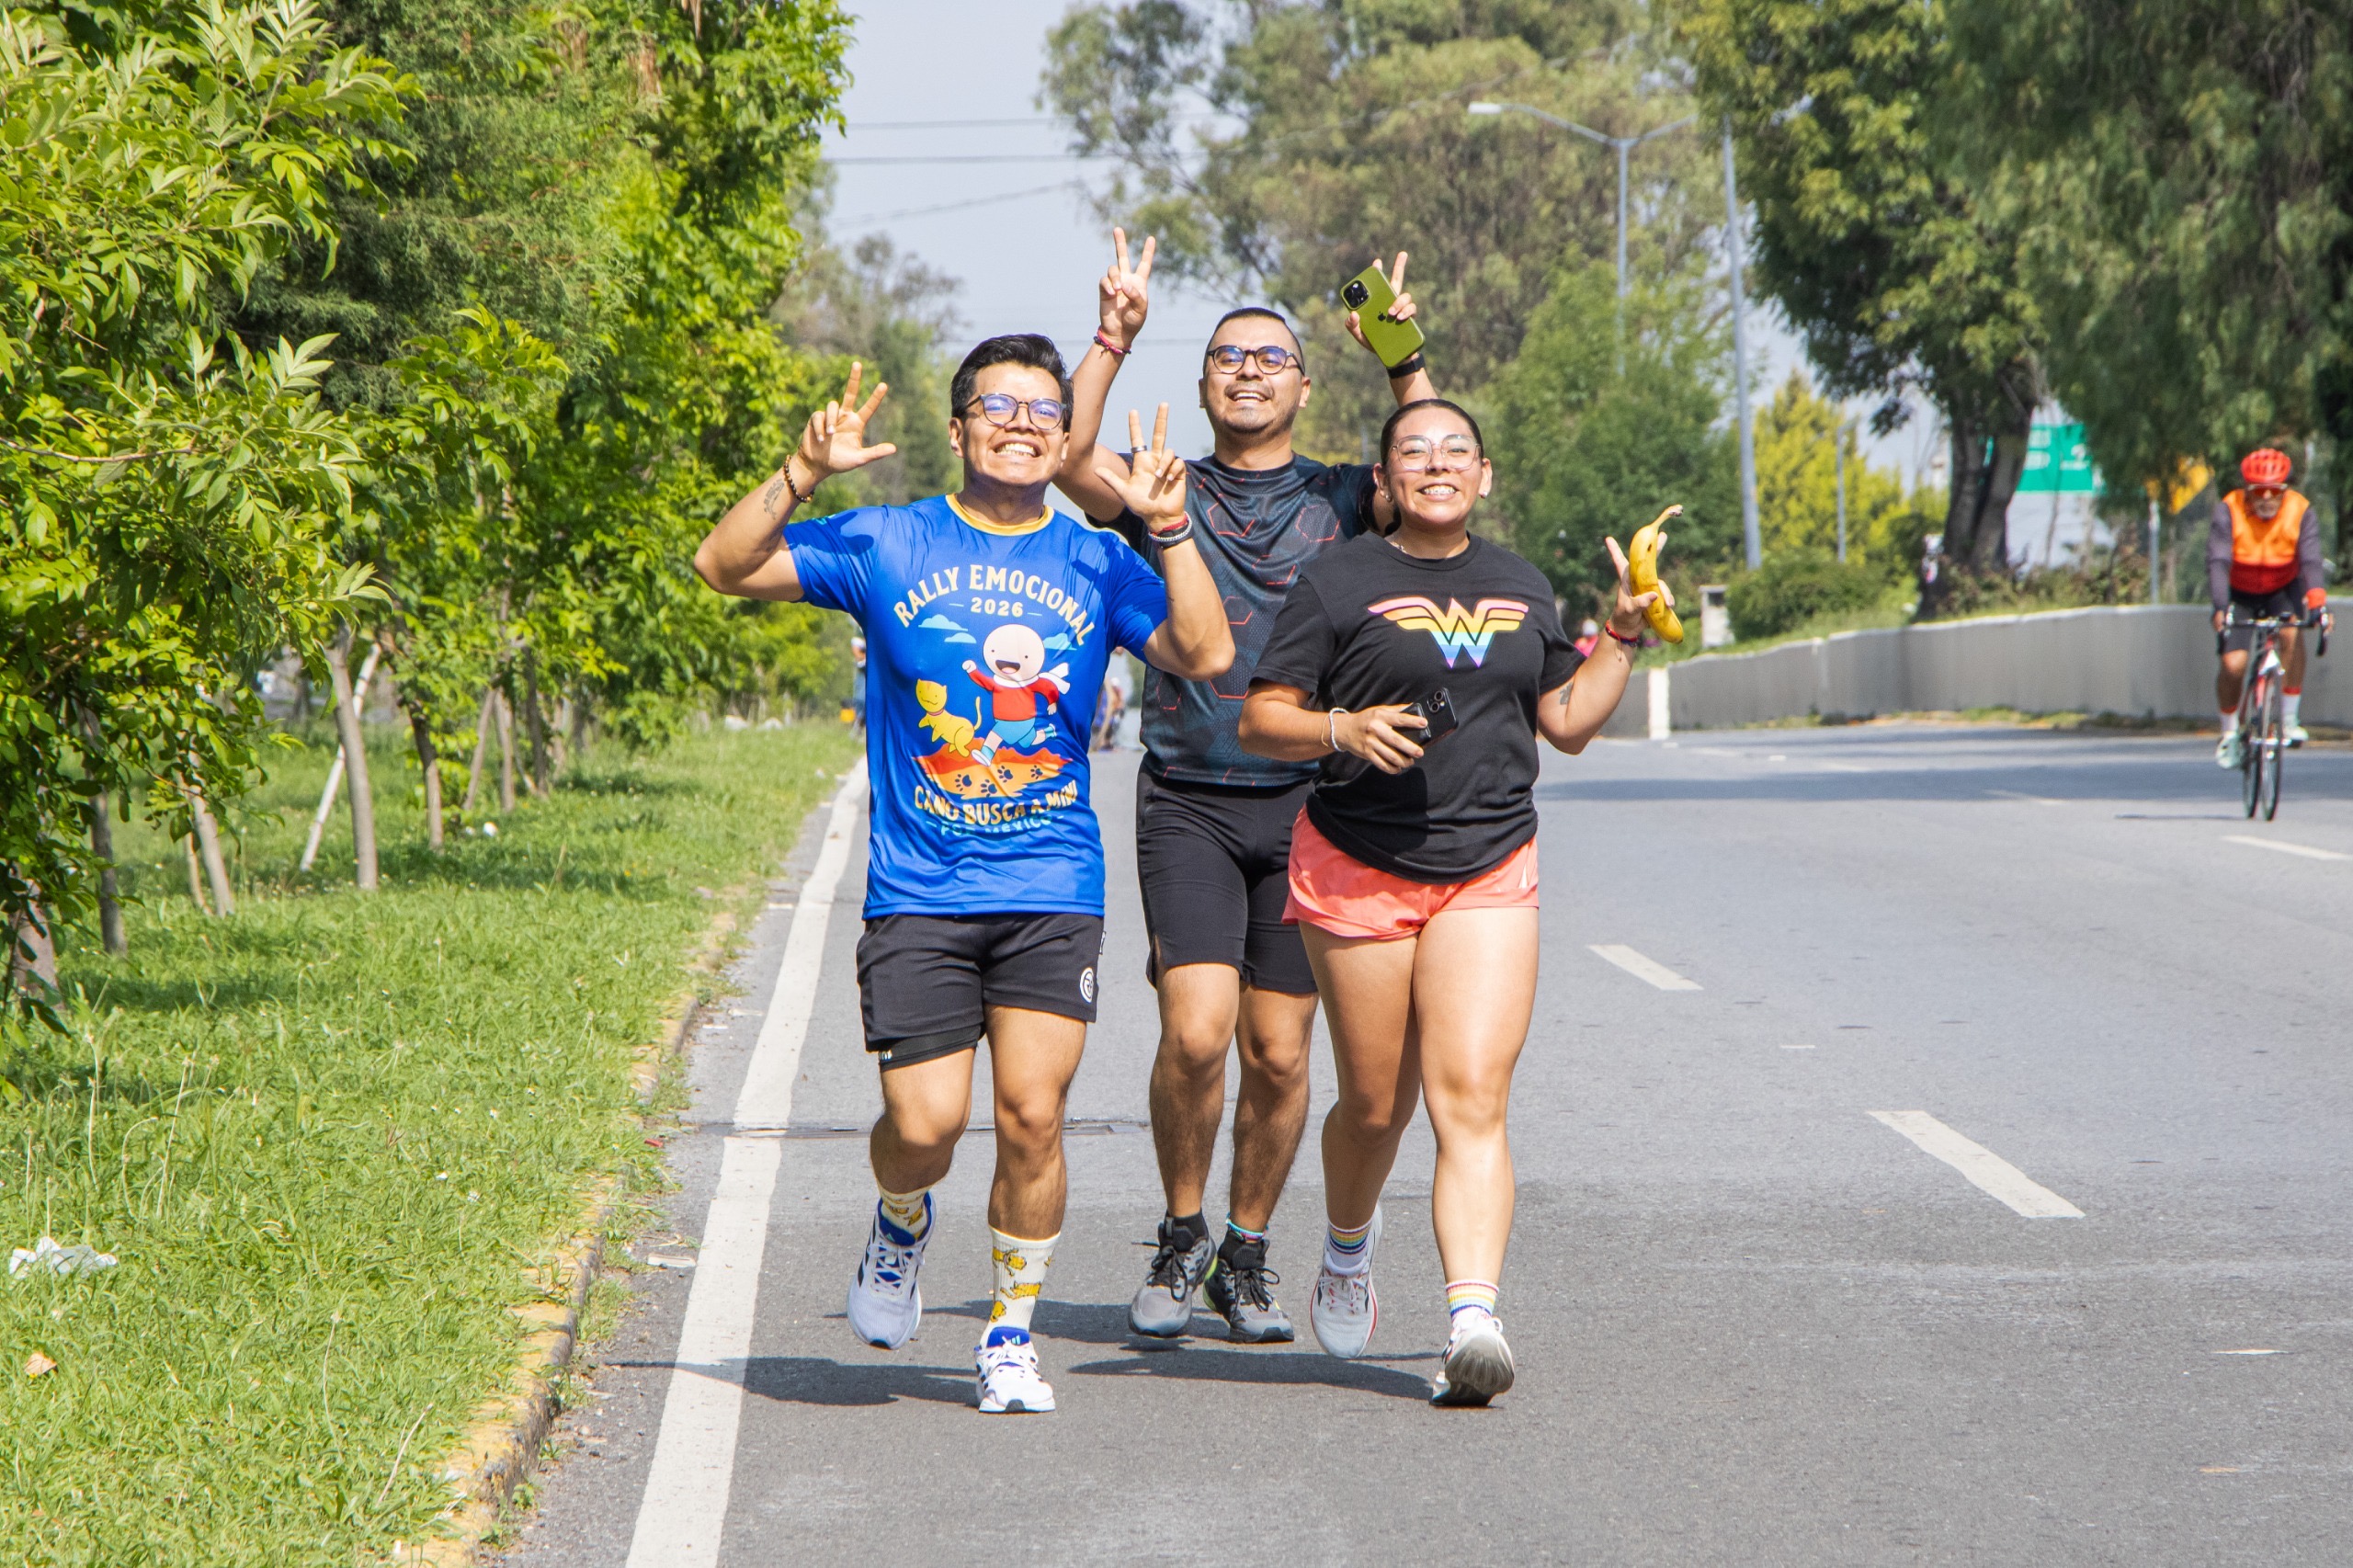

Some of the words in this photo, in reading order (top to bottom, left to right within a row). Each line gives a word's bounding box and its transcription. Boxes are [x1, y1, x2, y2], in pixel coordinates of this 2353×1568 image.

[893, 566, 960, 628] RALLY
[969, 564, 1095, 646] EMOCIONAL
[971, 597, 1024, 618] 2026
[915, 785, 960, 821] CANO
[962, 802, 1026, 825] BUSCA
[1030, 798, 1045, 814] A
[1045, 779, 1078, 811] MINI
